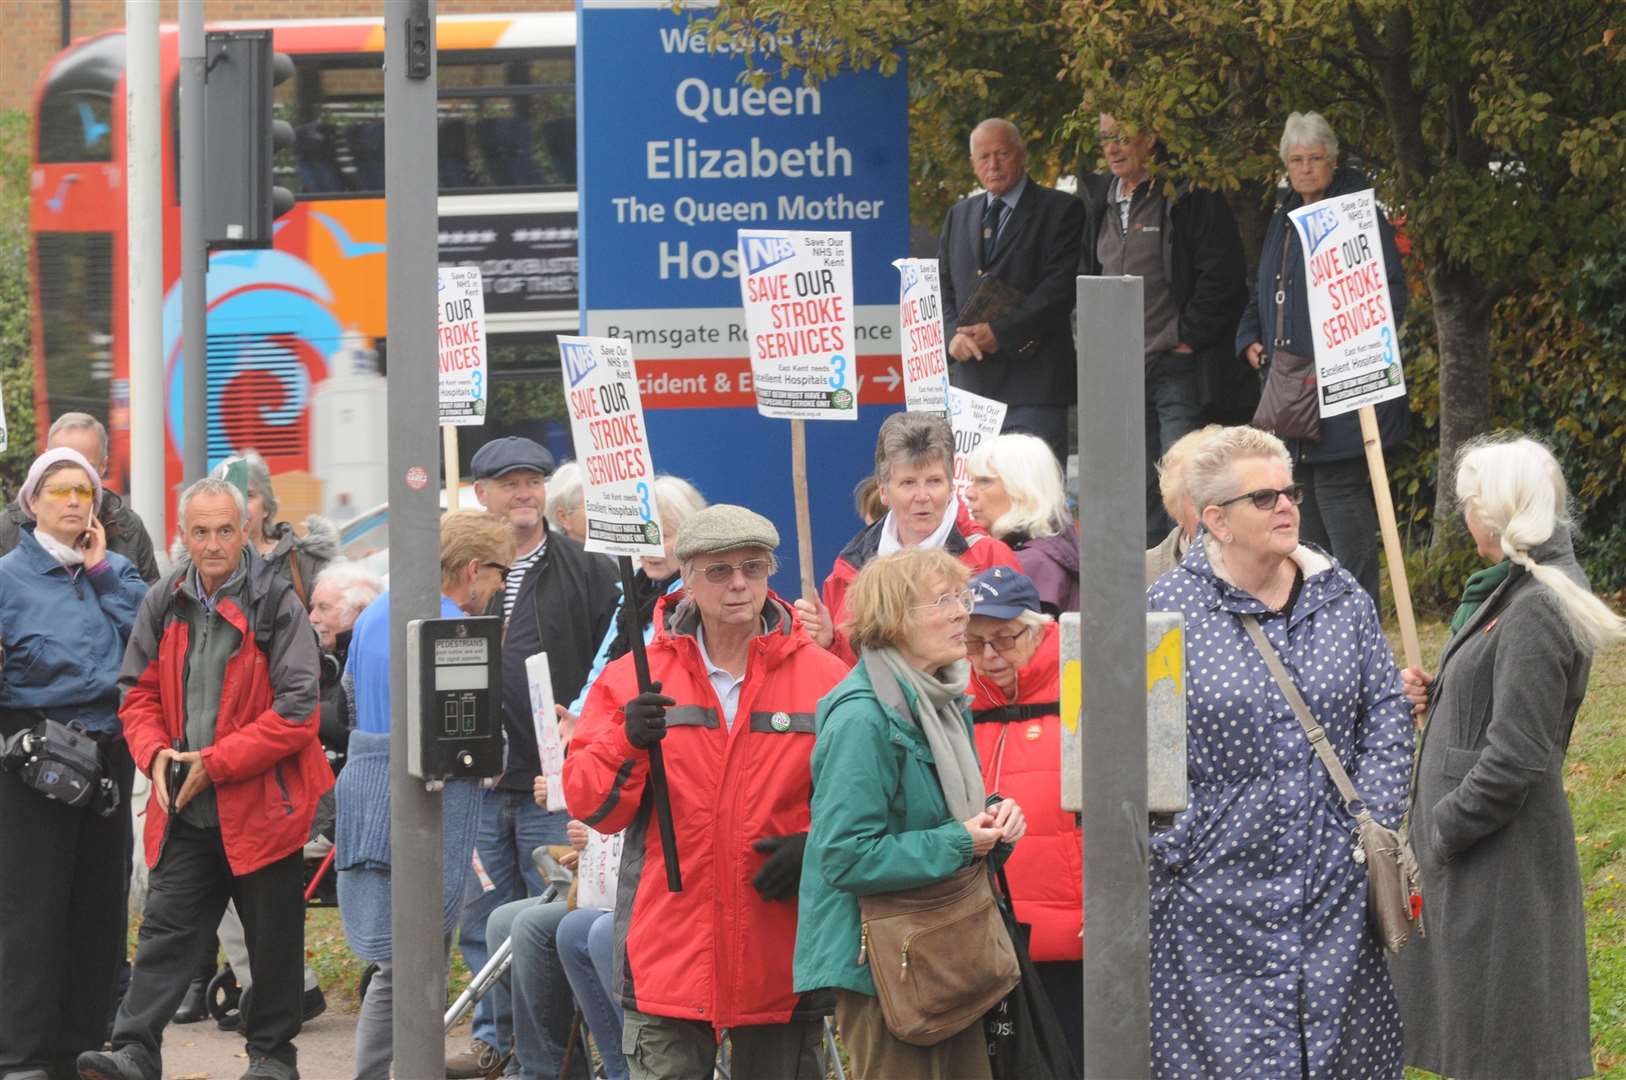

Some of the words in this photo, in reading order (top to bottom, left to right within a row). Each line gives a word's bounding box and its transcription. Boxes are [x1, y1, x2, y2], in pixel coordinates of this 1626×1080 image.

[675, 77, 822, 123] Queen
[646, 136, 853, 180] Elizabeth
[612, 196, 666, 223] The
[674, 196, 768, 226] Queen
[778, 193, 884, 222] Mother
[745, 237, 795, 273] NHS
[804, 237, 825, 247] Save
[827, 237, 844, 247] Our
[812, 247, 832, 257] NHS
[835, 247, 844, 257] in
[823, 257, 845, 267] Kent
[1310, 247, 1344, 289] SAVE
[1342, 233, 1373, 269] OUR
[748, 274, 791, 303] SAVE
[794, 269, 835, 297] OUR
[1327, 261, 1384, 311] STROKE
[445, 298, 473, 322] OUR
[770, 296, 846, 330] STROKE
[919, 294, 938, 321] OUR
[1322, 294, 1388, 350] SERVICES
[438, 320, 481, 348] TROKE
[600, 344, 615, 356] Save
[608, 324, 720, 349] Ramsgate
[756, 325, 844, 360] SERVICES
[910, 319, 943, 352] STROKE
[1380, 325, 1393, 365] 3
[439, 345, 481, 374] VICES
[565, 344, 596, 382] NHS
[607, 356, 622, 368] NHS
[828, 354, 847, 390] 3
[908, 349, 945, 383] SERVICES
[472, 370, 482, 399] 3
[638, 372, 707, 395] cident
[713, 371, 732, 392] &
[784, 374, 828, 387] Hospitals
[570, 387, 600, 420] SAVE
[600, 382, 630, 414] OUR
[986, 404, 1001, 416] Our
[588, 414, 643, 451] STROKE
[586, 447, 646, 486] SERVICES
[636, 482, 652, 523] 3
[436, 639, 484, 649] PEDESTRIANS
